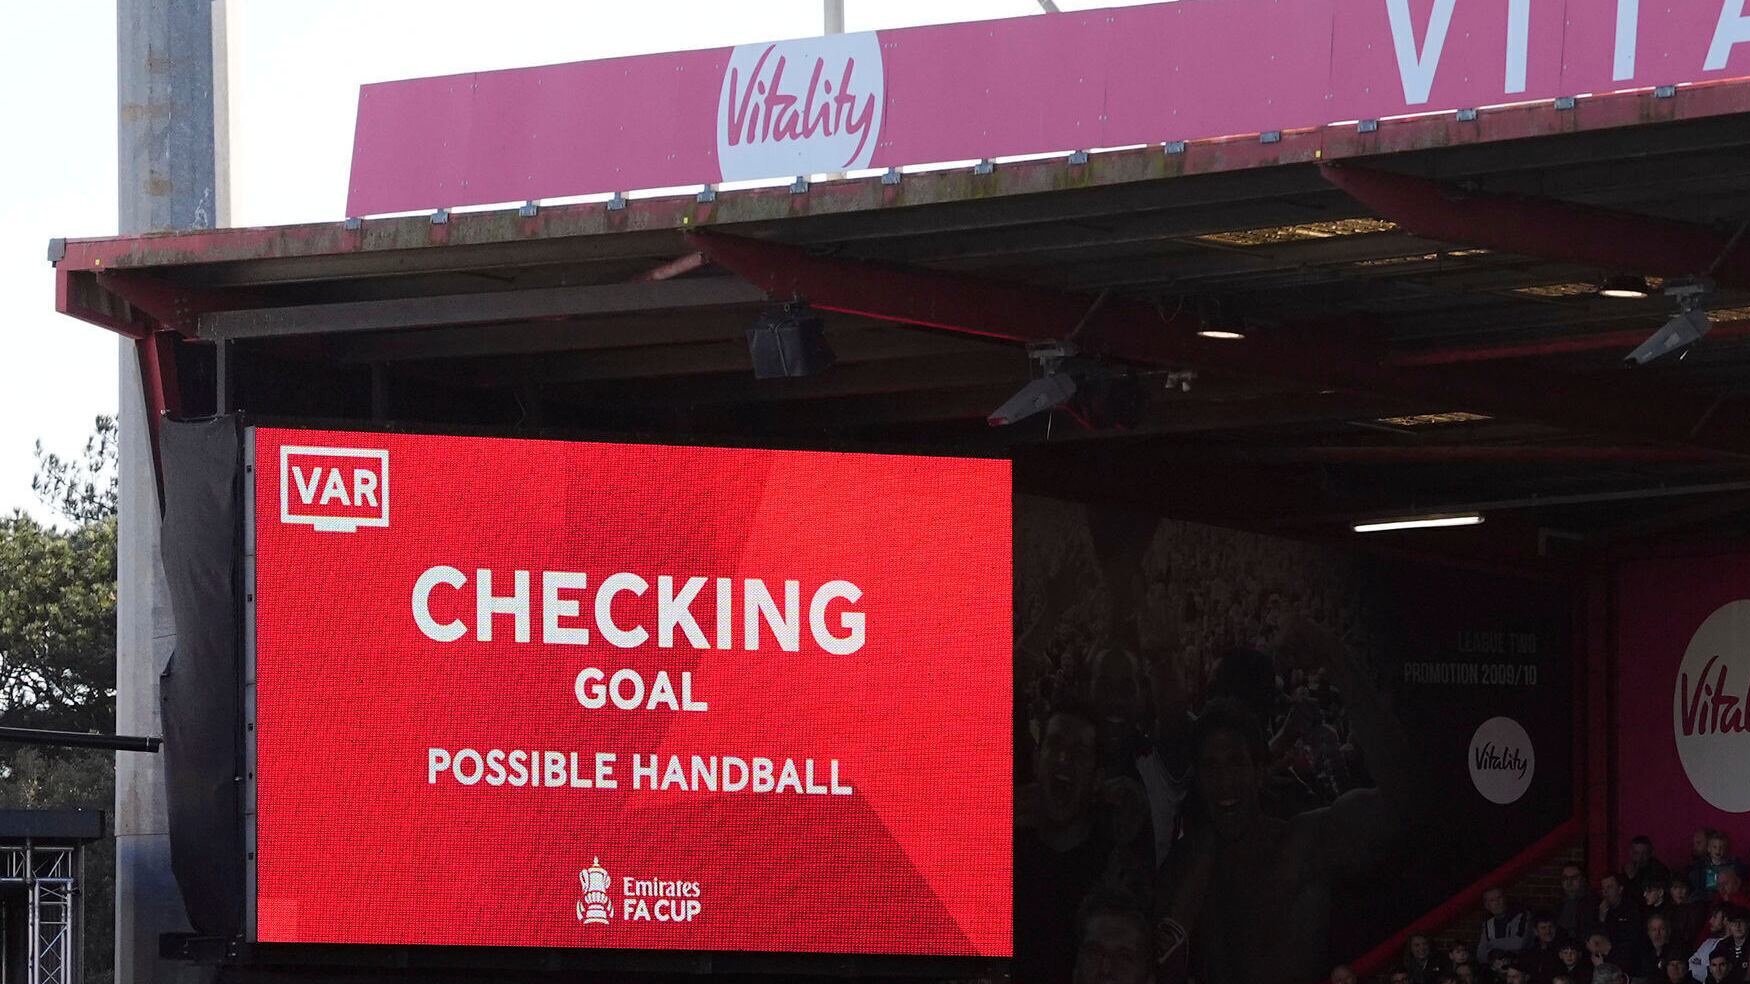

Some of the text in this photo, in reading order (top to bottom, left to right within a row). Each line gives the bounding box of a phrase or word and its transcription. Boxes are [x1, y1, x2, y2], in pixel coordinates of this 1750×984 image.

[728, 44, 875, 168] Vitality
[291, 466, 378, 507] VAR
[412, 565, 866, 655] CHECKING
[1457, 631, 1537, 653] LEAGUE TWO
[574, 667, 708, 712] GOAL
[1404, 663, 1537, 685] PROMOTION 2009/10
[428, 748, 852, 795] POSSIBLE HANDBALL
[1475, 743, 1527, 780] Vitality
[623, 877, 700, 897] Emirates
[624, 899, 701, 922] FA CUP
